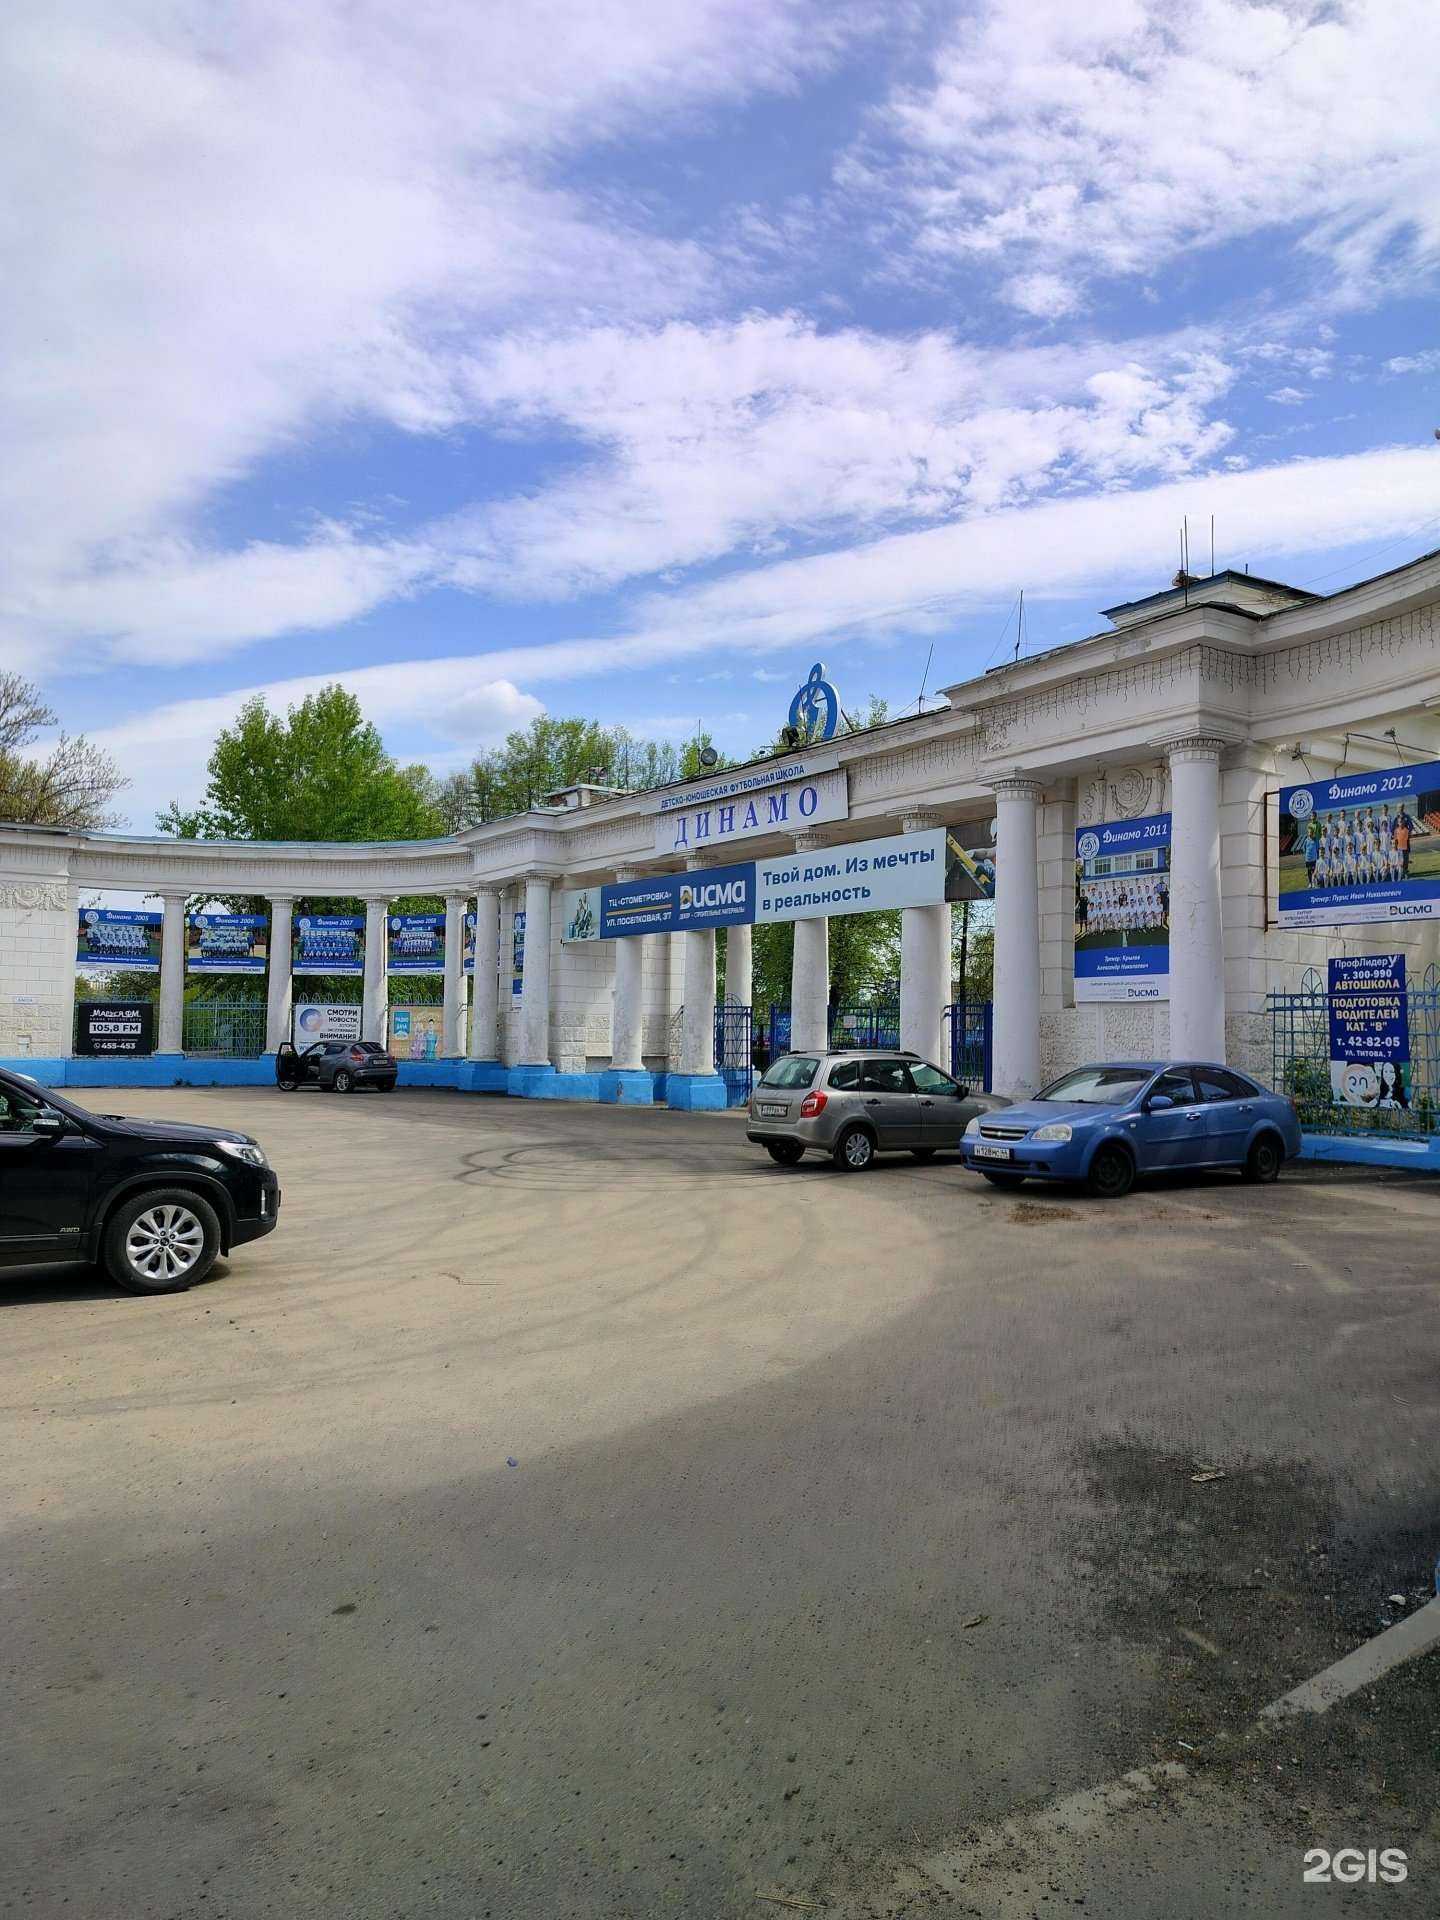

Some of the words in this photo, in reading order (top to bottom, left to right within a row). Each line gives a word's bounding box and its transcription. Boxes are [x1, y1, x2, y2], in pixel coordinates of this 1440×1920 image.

[661, 785, 728, 809] ДЕТСКО-ЮНОШЕСКАЯ
[729, 773, 775, 792] ФУТБОЛЬНАЯ
[775, 764, 805, 781] ШКОЛА
[1328, 783, 1377, 800] Динамо
[1380, 774, 1413, 792] 2012
[674, 787, 818, 848] ДИНАМО
[1102, 829, 1141, 844] Динамо
[1143, 823, 1167, 838] 2011
[763, 867, 800, 886] Твой
[804, 863, 841, 883] дом.
[846, 857, 868, 874] Из
[873, 848, 935, 870] мечты
[608, 898, 618, 908] ТЦ
[618, 891, 672, 906] «СТОМЕТРОВКА»
[762, 900, 771, 911] в
[774, 885, 871, 912] реальность
[1352, 969, 1392, 980] 300-990
[1335, 979, 1400, 991] АВТОШКОЛА
[1332, 996, 1400, 1010] ПОДГОТОВКА
[327, 1008, 358, 1017] СМОТРИ
[1336, 1007, 1399, 1021] ВОДИТЕЛЕЙ
[93, 1024, 120, 1033] 105,8
[123, 1024, 139, 1032] FM
[1346, 1022, 1368, 1032] КАТ.
[319, 1032, 357, 1040] ВНИМАНИЯ
[1348, 1036, 1400, 1047] 42-82-05
